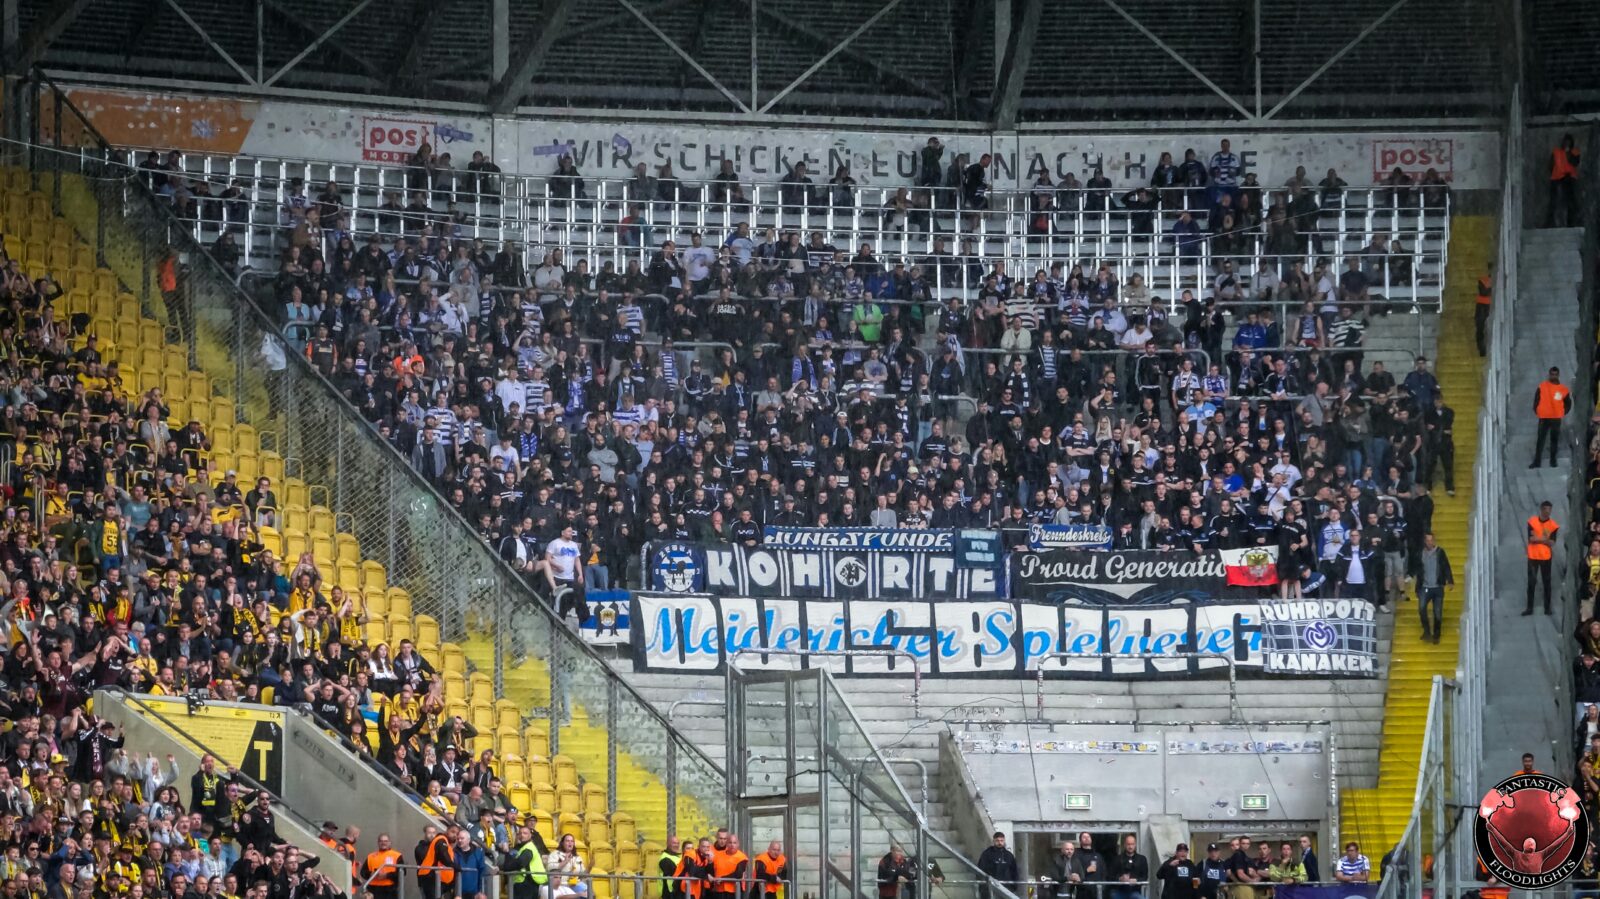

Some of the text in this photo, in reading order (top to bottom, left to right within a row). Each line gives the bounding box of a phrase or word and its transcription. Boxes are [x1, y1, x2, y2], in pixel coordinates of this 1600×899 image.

[370, 126, 430, 148] post
[653, 142, 850, 176] SCHICKEN
[1030, 524, 1111, 543] Freundeskreis
[1020, 552, 1228, 583] Proud Generatio
[1260, 600, 1376, 621] RUHRPOTT
[1270, 652, 1373, 672] KANAKEN
[254, 741, 273, 781] T
